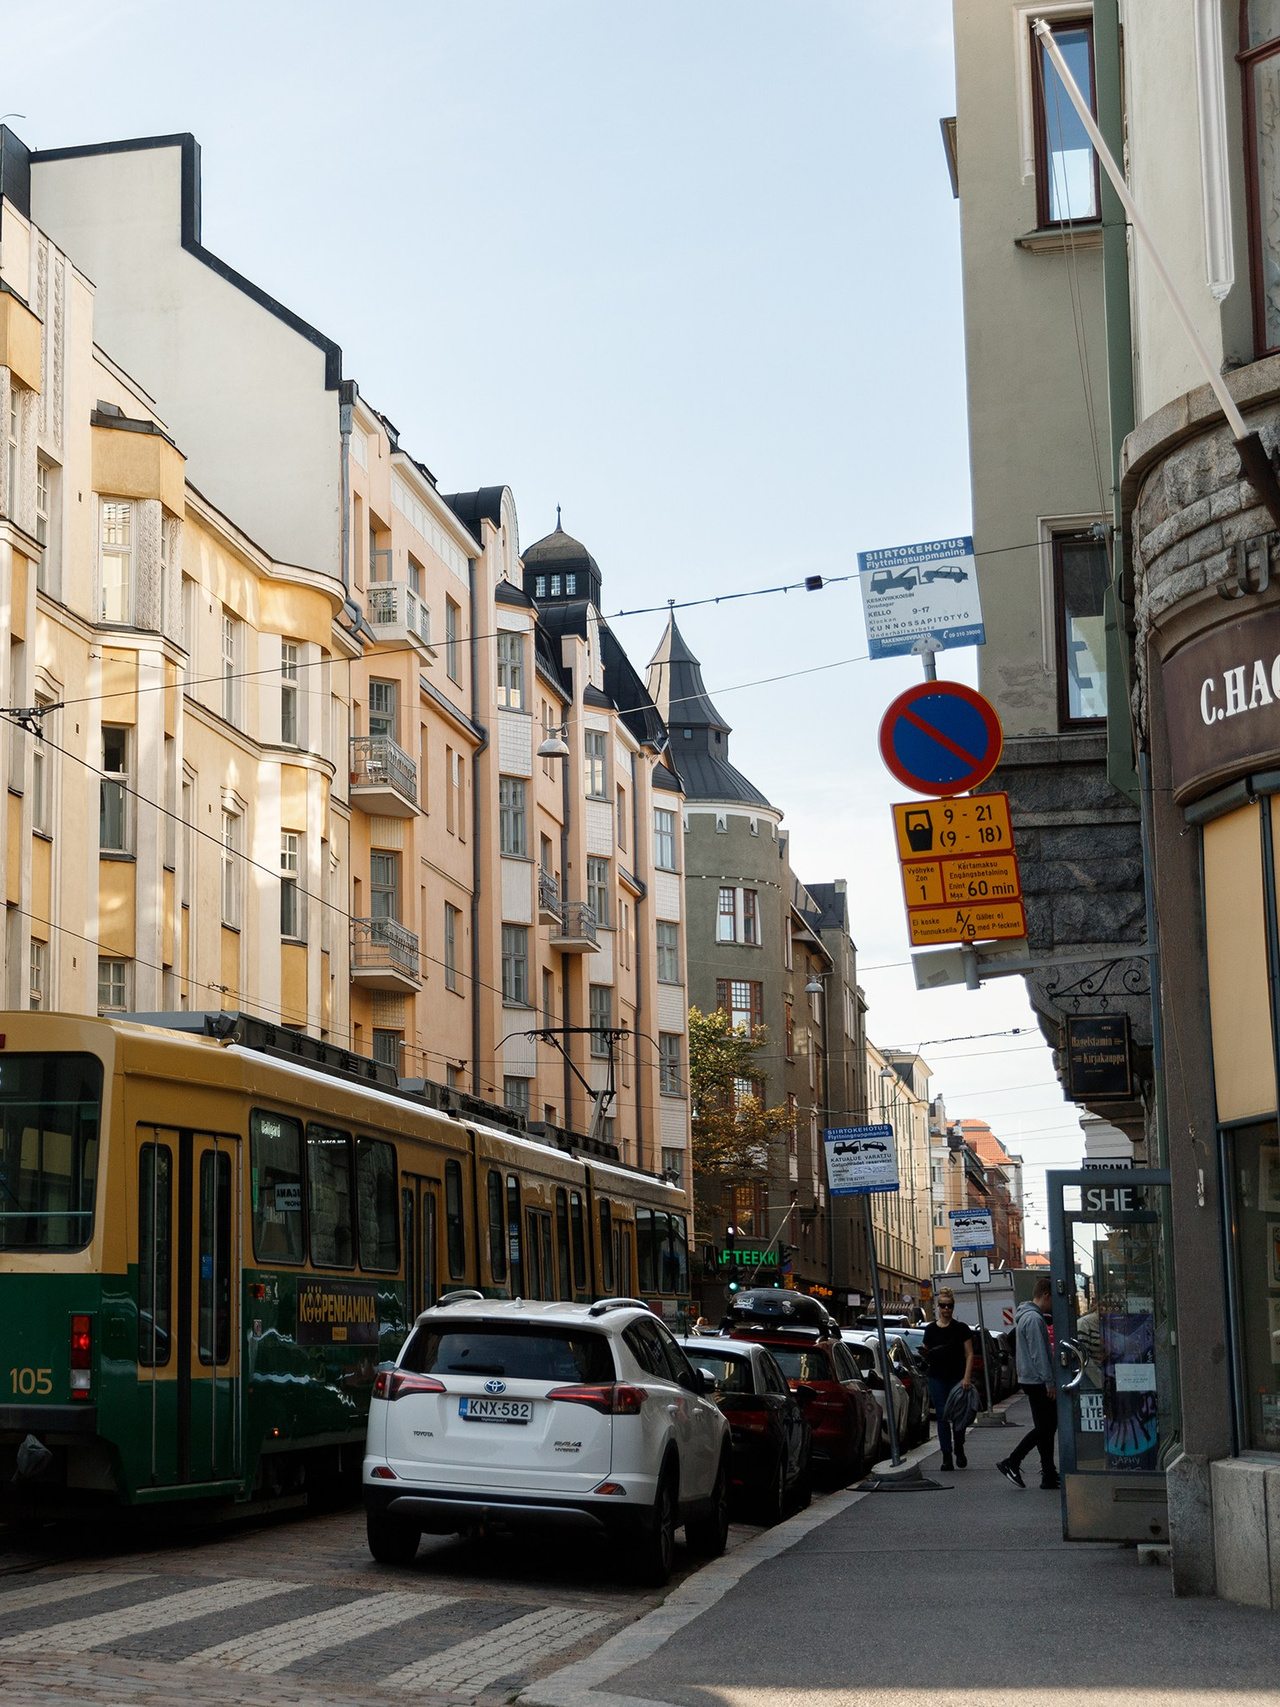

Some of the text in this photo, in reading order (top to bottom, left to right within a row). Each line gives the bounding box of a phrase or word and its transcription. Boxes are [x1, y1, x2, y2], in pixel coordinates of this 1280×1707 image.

[866, 539, 965, 561] SIIRTOKEHOTUS
[866, 548, 966, 569] Flyttningsuppmaning
[868, 606, 930, 618] KELLO 9-17
[869, 617, 897, 625] Klockan
[869, 611, 970, 633] KUNNOSSAPITOTYÖ
[943, 808, 955, 825] 9
[975, 804, 993, 821] 21
[939, 831, 956, 847] (9
[978, 825, 1003, 844] 18)
[907, 866, 935, 875] Vyöhyke
[957, 860, 998, 870] Kertamaksu
[915, 874, 928, 882] Zon
[949, 868, 1009, 880] Engångsbetalning
[920, 885, 927, 900] 1
[948, 880, 1015, 897] Enint 60 min
[950, 891, 964, 899] Max
[912, 918, 919, 927] Ei
[920, 917, 940, 926] koske
[976, 912, 995, 921] Gäller
[997, 912, 1004, 920] ej
[913, 921, 1020, 937] P-tunnuksella med P-tecknet
[1083, 1052, 1125, 1065] Kirjakauppa
[827, 1125, 889, 1135] SIIRTOKEHOTUS
[1086, 1188, 1134, 1212] SHE
[299, 1285, 376, 1323] KÖÖPENHAMINA
[10, 1367, 53, 1394] 105
[470, 1400, 529, 1417] KNX-582
[1088, 1396, 1102, 1406] WI
